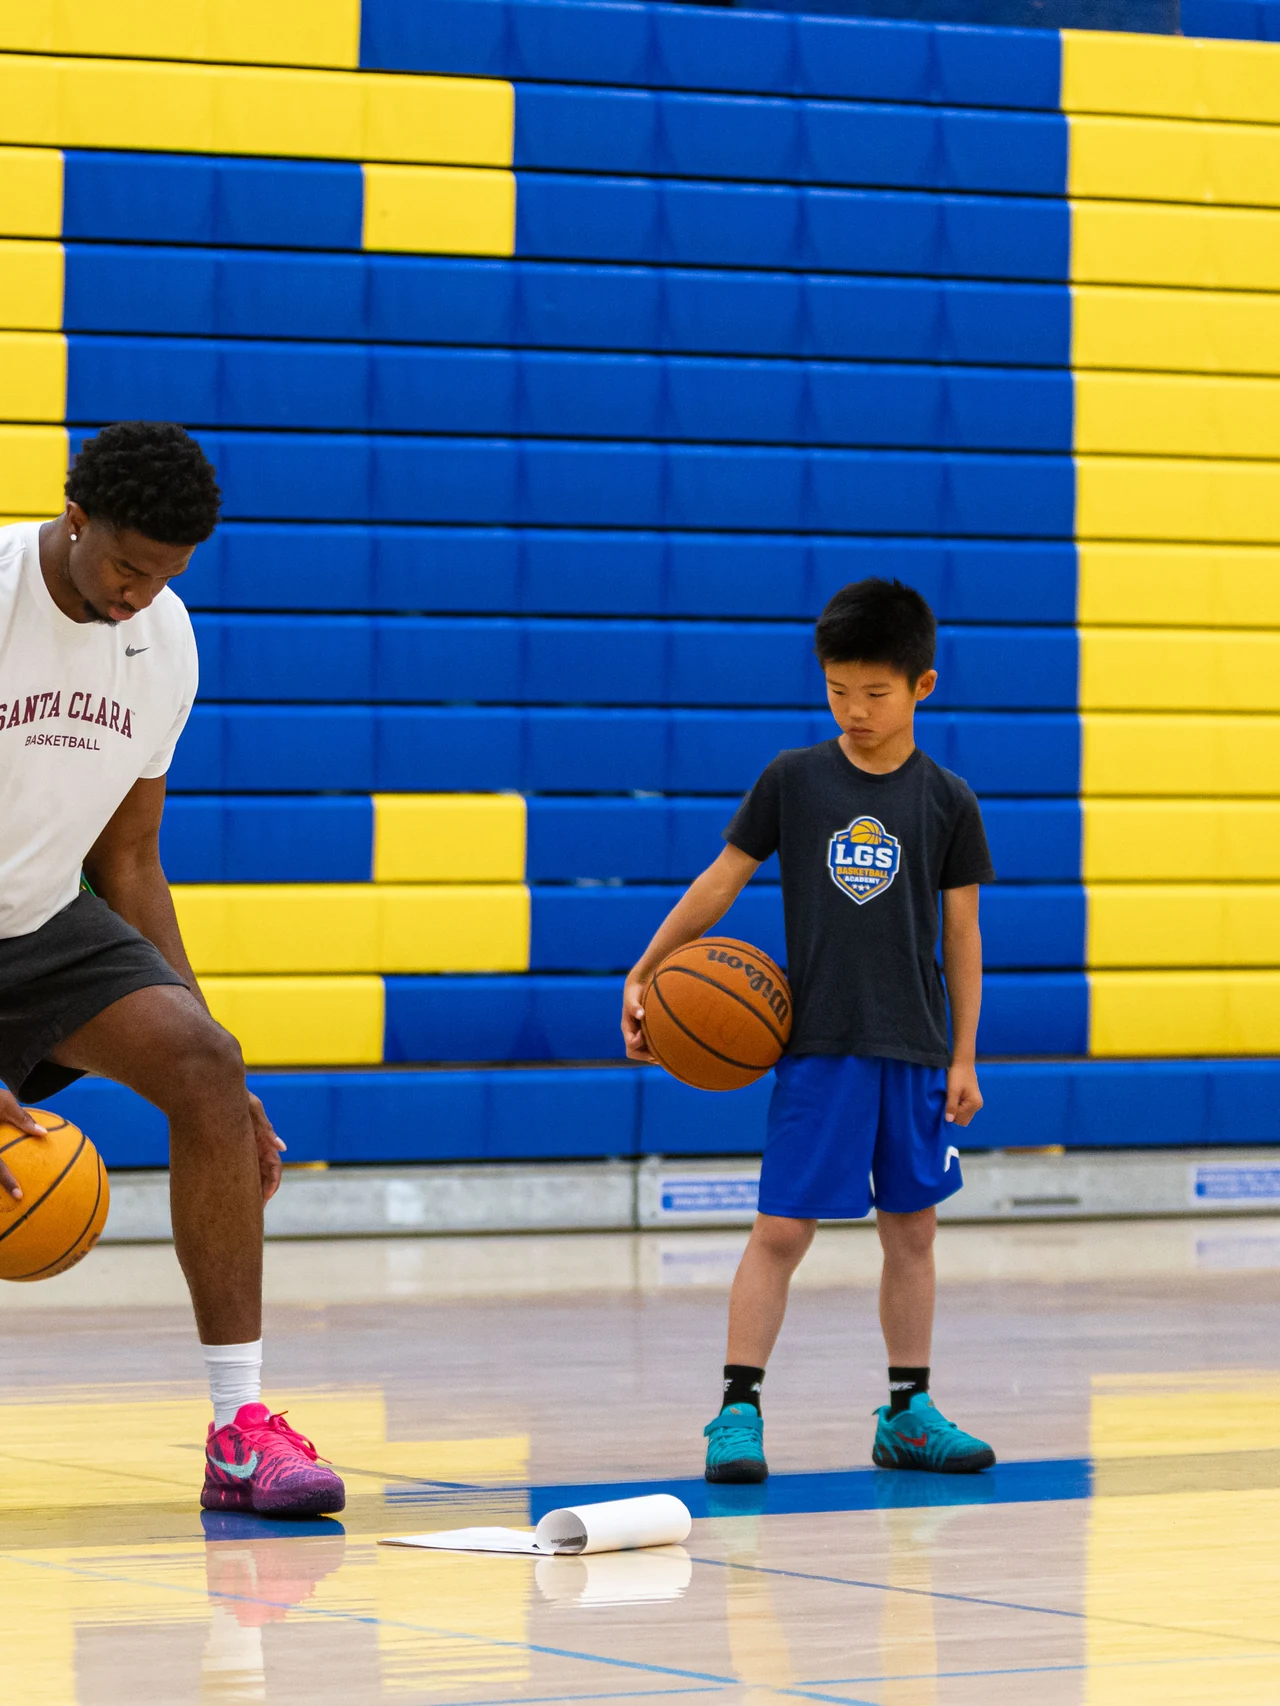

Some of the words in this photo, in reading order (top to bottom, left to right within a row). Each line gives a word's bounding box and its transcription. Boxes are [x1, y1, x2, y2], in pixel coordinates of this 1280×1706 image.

[67, 691, 133, 739] CLARA
[24, 733, 101, 751] BASKETBALL
[834, 843, 894, 869] LGS
[836, 866, 889, 879] BASKETBALL
[844, 875, 881, 885] ACADEMY
[706, 948, 790, 1027] Wilson
